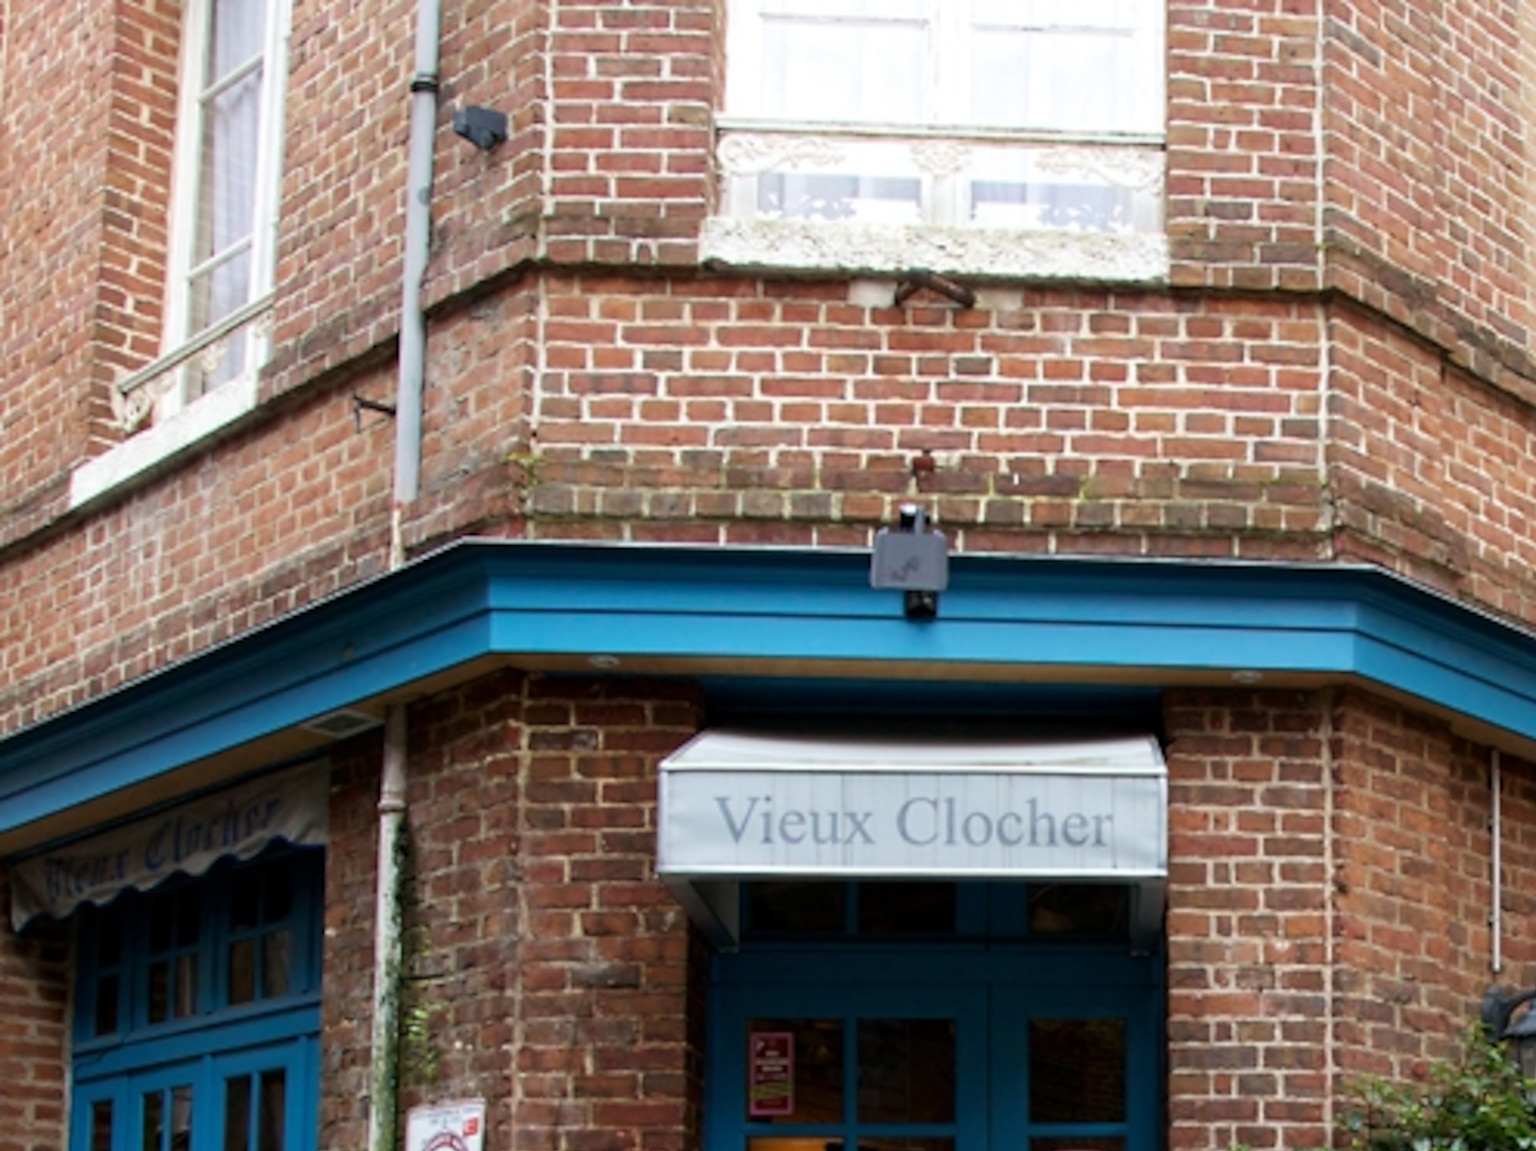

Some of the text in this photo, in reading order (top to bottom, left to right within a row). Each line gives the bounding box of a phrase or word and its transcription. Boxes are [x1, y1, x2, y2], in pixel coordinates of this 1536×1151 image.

[143, 797, 281, 872] Clocher
[714, 795, 1115, 848] Vieux Clocher
